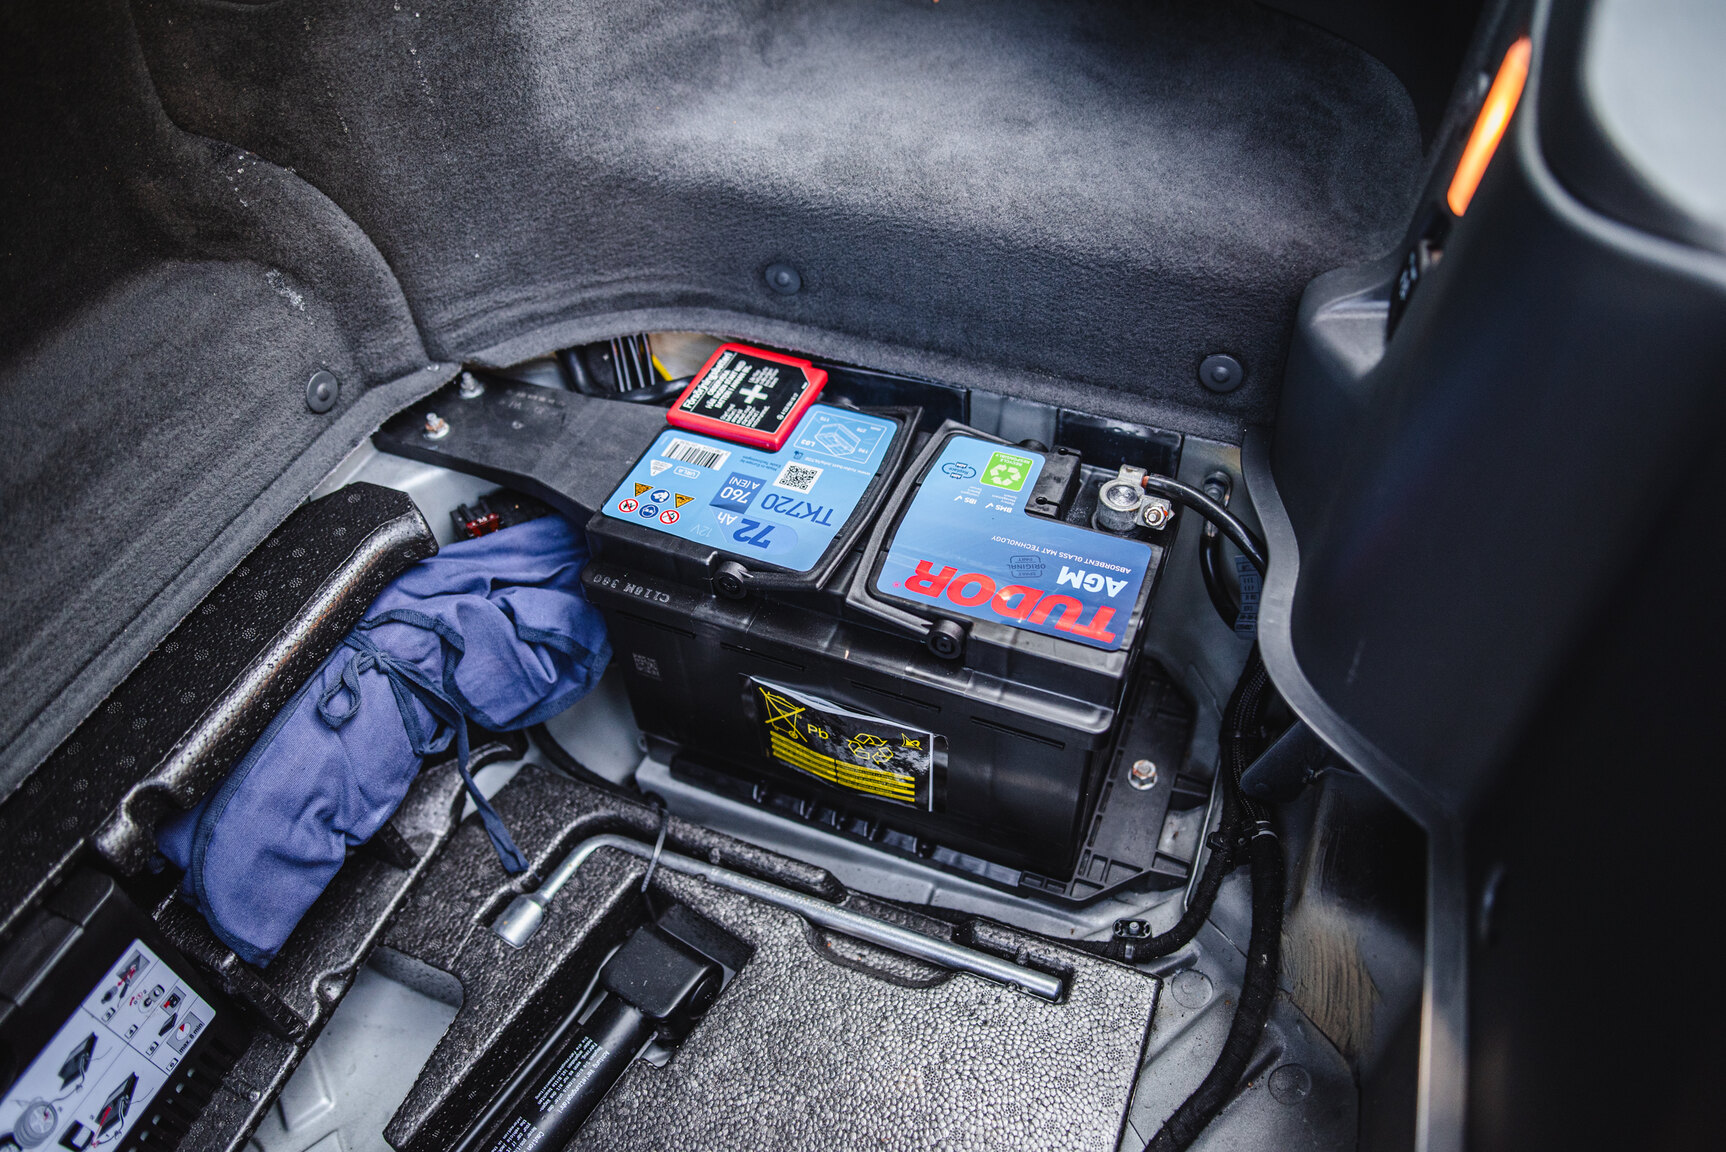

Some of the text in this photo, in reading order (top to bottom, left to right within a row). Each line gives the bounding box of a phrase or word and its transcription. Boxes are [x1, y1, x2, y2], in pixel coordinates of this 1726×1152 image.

[720, 486, 751, 504] 760
[760, 493, 834, 526] TK720
[995, 504, 1013, 513] BMS
[717, 511, 776, 549] 72 Ah
[991, 535, 1131, 574] ABSORBENT GLASS MAT TECHNOLOGY
[1056, 565, 1128, 598] AGM
[904, 559, 1117, 643] TUDOR
[808, 724, 829, 740] Pb
[178, 1040, 191, 1053] max.
[193, 1023, 203, 1035] min
[526, 1130, 545, 1151] Caution
[527, 1126, 538, 1139] Never
